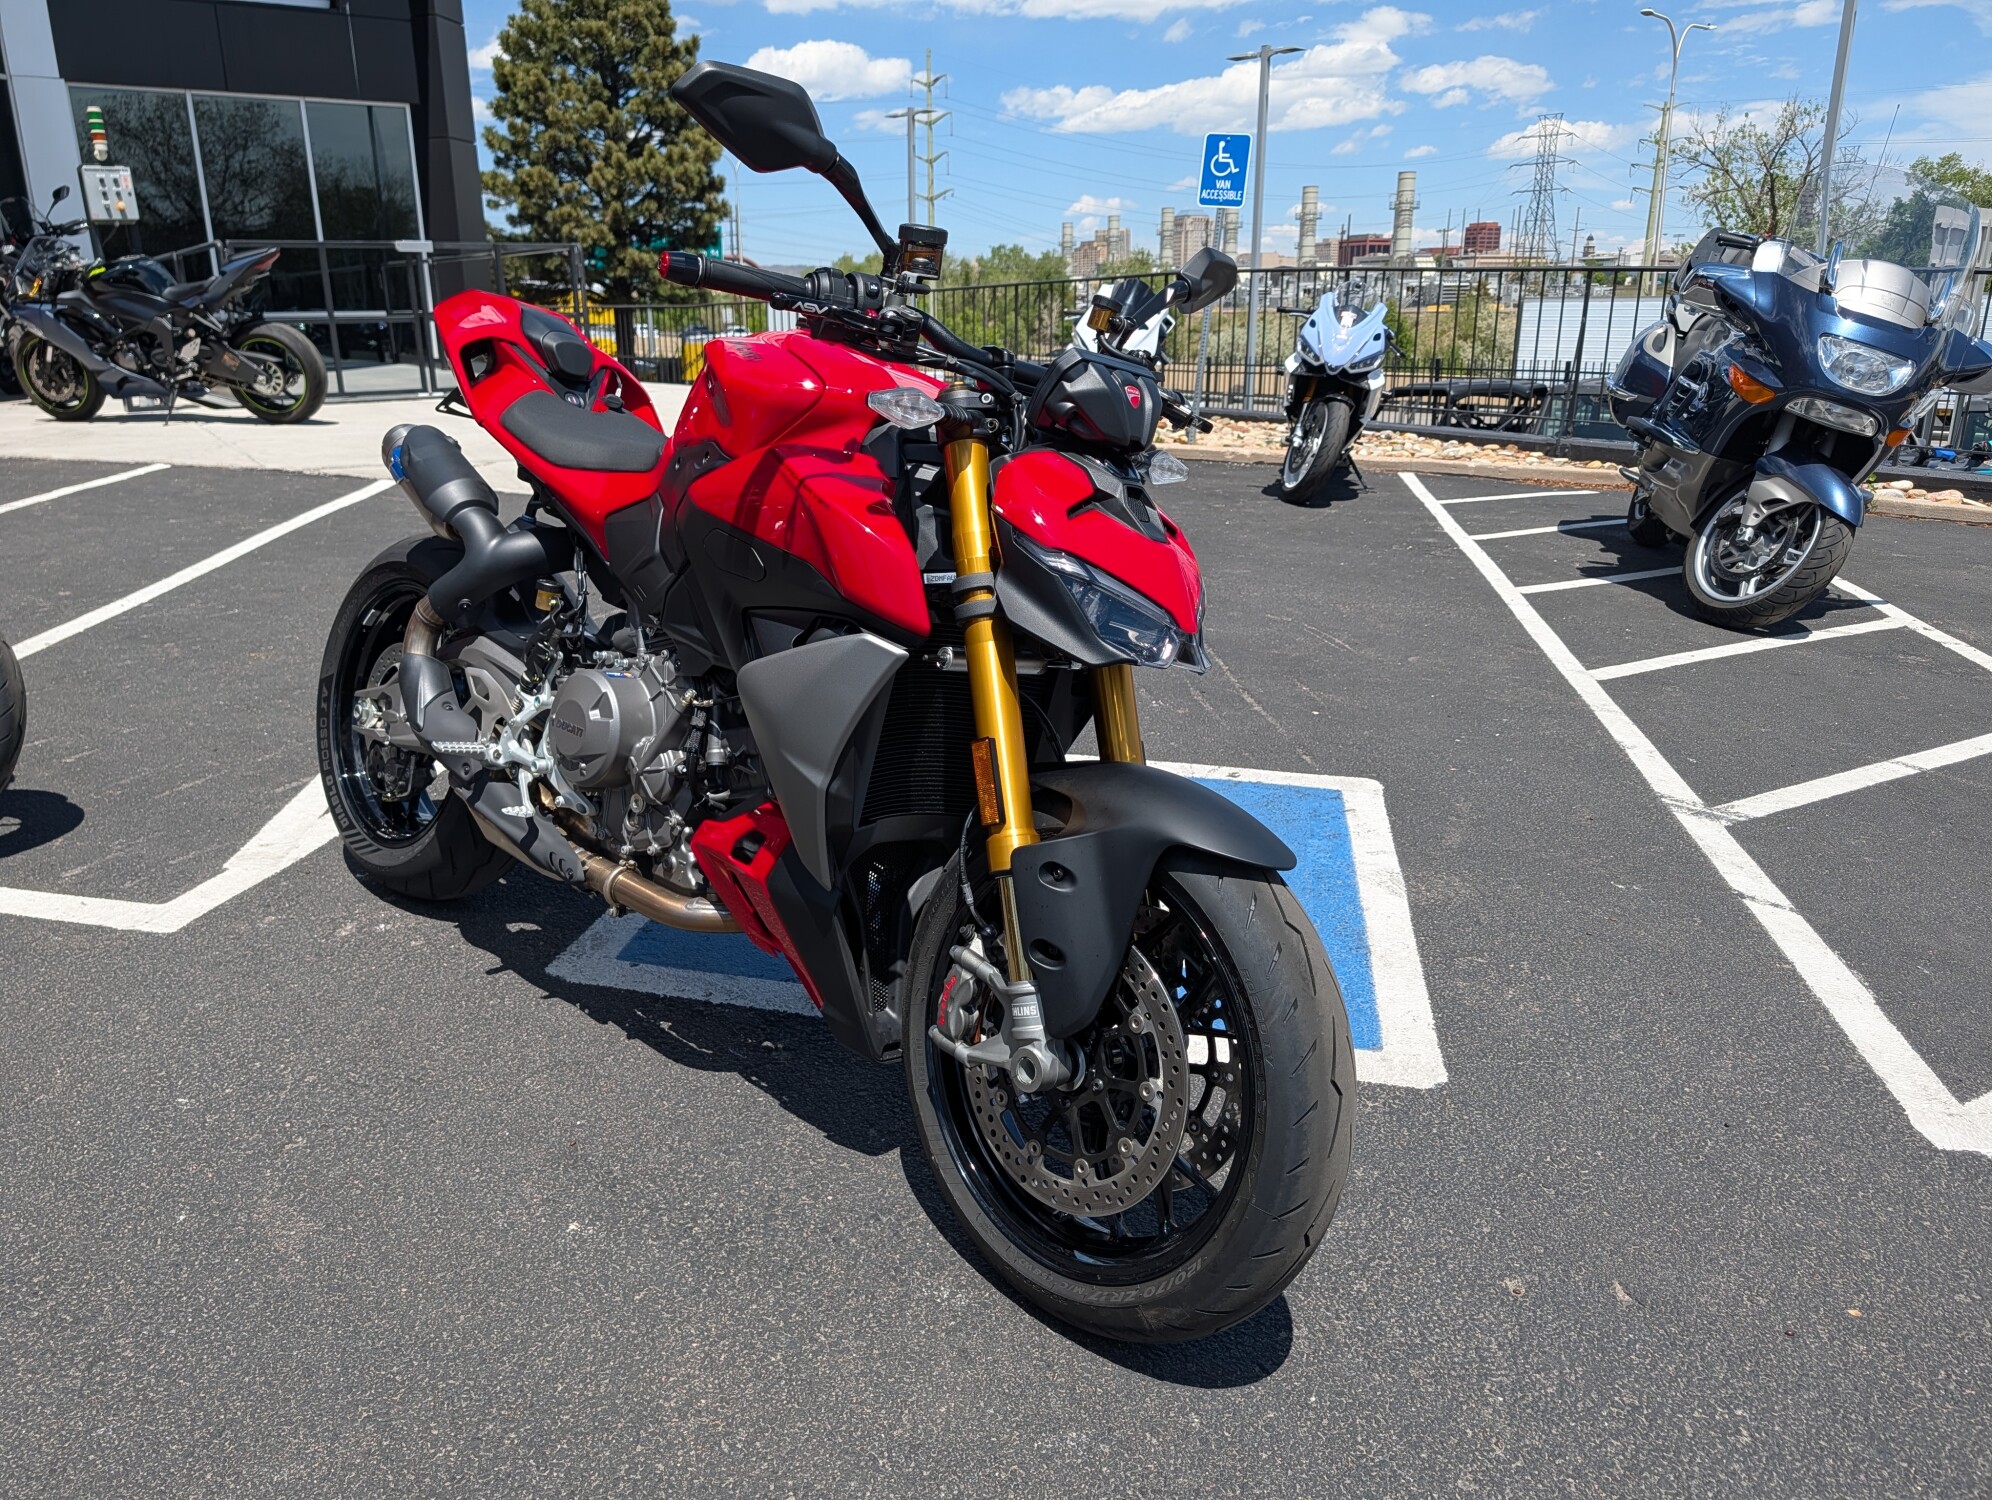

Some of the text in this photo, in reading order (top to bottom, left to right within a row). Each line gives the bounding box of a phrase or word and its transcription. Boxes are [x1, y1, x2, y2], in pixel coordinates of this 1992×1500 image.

[1215, 179, 1232, 190] VAN
[1200, 189, 1243, 201] ACCESSIBLE
[791, 301, 829, 314] ASV
[555, 718, 584, 738] DUCATI
[320, 717, 331, 771] ROSSO
[325, 775, 350, 829] DIABLO
[939, 976, 957, 1025] brembo
[1011, 1004, 1037, 1017] HLINS
[1143, 1257, 1203, 1298] 120/70
